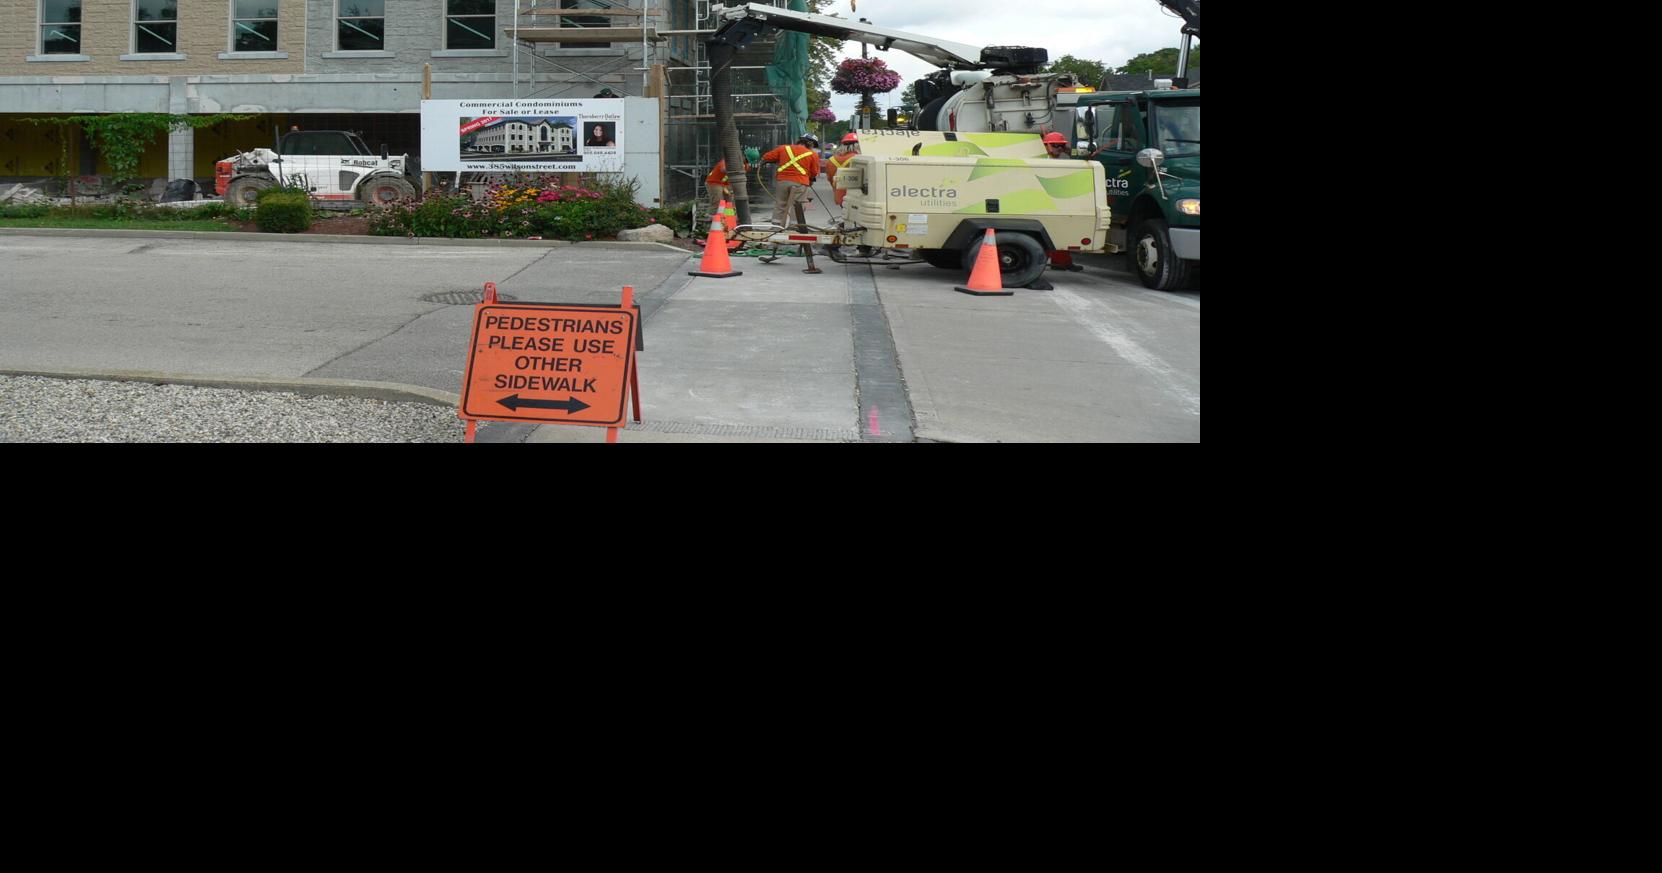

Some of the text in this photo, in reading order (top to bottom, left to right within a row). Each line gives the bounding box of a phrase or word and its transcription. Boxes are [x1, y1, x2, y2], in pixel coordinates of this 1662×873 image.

[460, 122, 481, 133] SPRING
[467, 163, 576, 171] www.385wilsonstreet.com
[1105, 178, 1129, 188] ctra
[890, 185, 957, 198] alectra
[920, 199, 957, 207] utilities
[485, 316, 623, 334] PEDESTRIANS
[488, 336, 615, 354] PLEASE USE
[515, 356, 582, 372] OTHER
[494, 374, 597, 393] SIDEWALK
